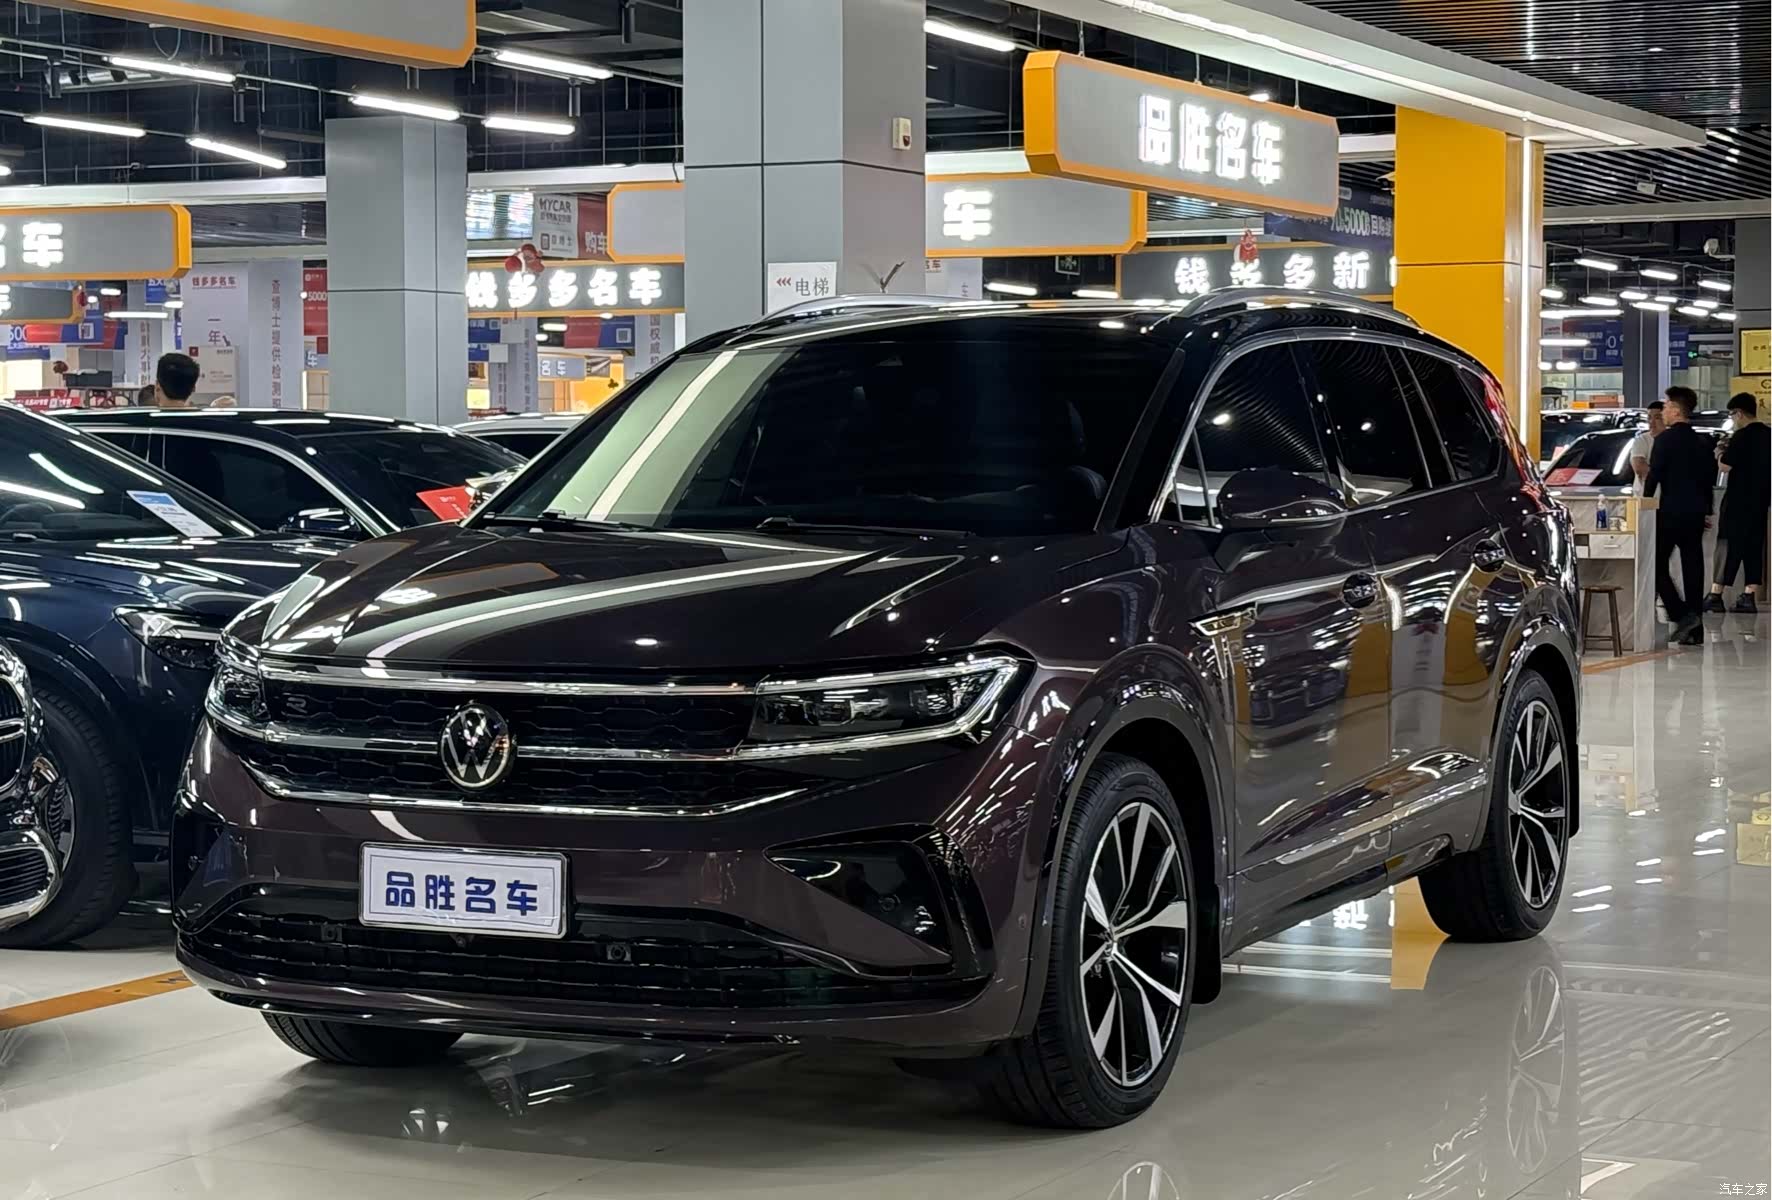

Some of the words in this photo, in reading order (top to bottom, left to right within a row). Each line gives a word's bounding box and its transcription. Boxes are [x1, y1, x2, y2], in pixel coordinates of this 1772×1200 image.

[1137, 94, 1283, 187] 品胜名车
[942, 188, 992, 241] 车
[0, 221, 64, 268] 车
[465, 267, 662, 308] 钱多多名车
[795, 277, 829, 297] 电梯
[1174, 250, 1397, 294] 钱多多新
[385, 870, 538, 916] 品胜名车
